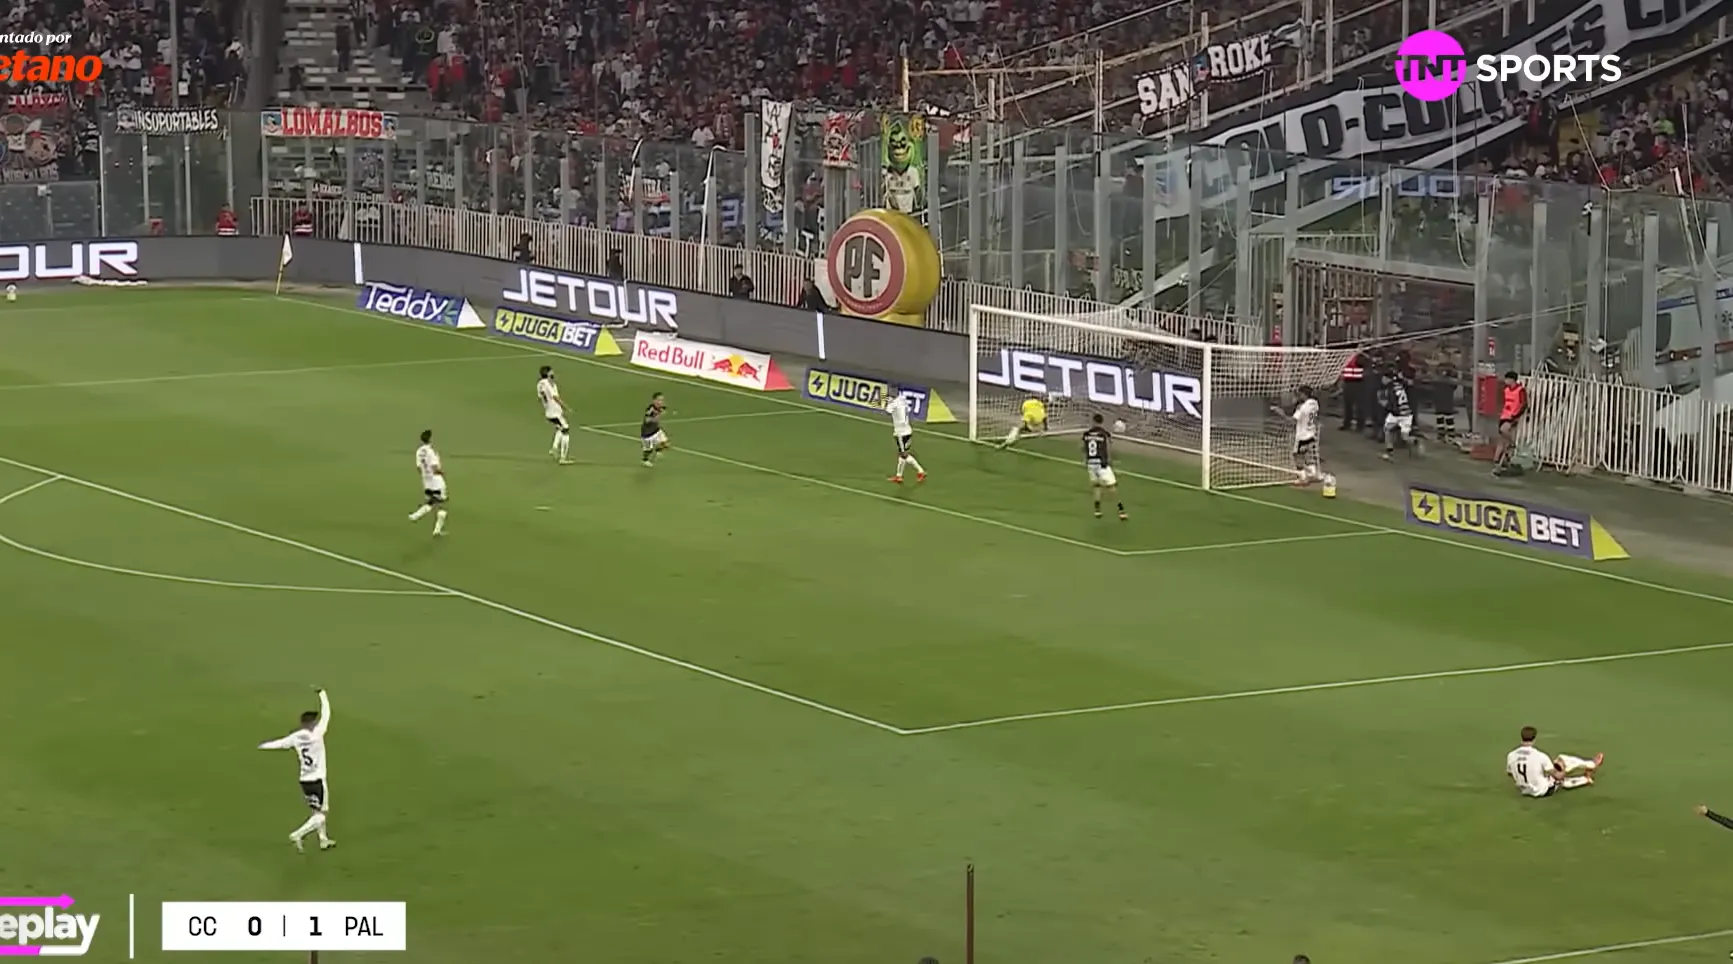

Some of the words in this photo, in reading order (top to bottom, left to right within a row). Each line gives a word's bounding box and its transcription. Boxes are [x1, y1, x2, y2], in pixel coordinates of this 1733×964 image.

[1137, 66, 1195, 115] SAN
[1207, 34, 1272, 78] ROKE
[134, 108, 219, 133] INSOPORTABLES
[281, 106, 384, 138] LOMALBOS
[843, 235, 885, 298] PF
[363, 280, 448, 322] Teddy
[502, 268, 678, 329] JETOUR
[637, 339, 669, 364] Red
[672, 346, 705, 370] Bull
[978, 348, 1201, 419] JETOUR
[1088, 439, 1098, 457] 8
[301, 747, 314, 767] 5
[1517, 763, 1528, 783] 4
